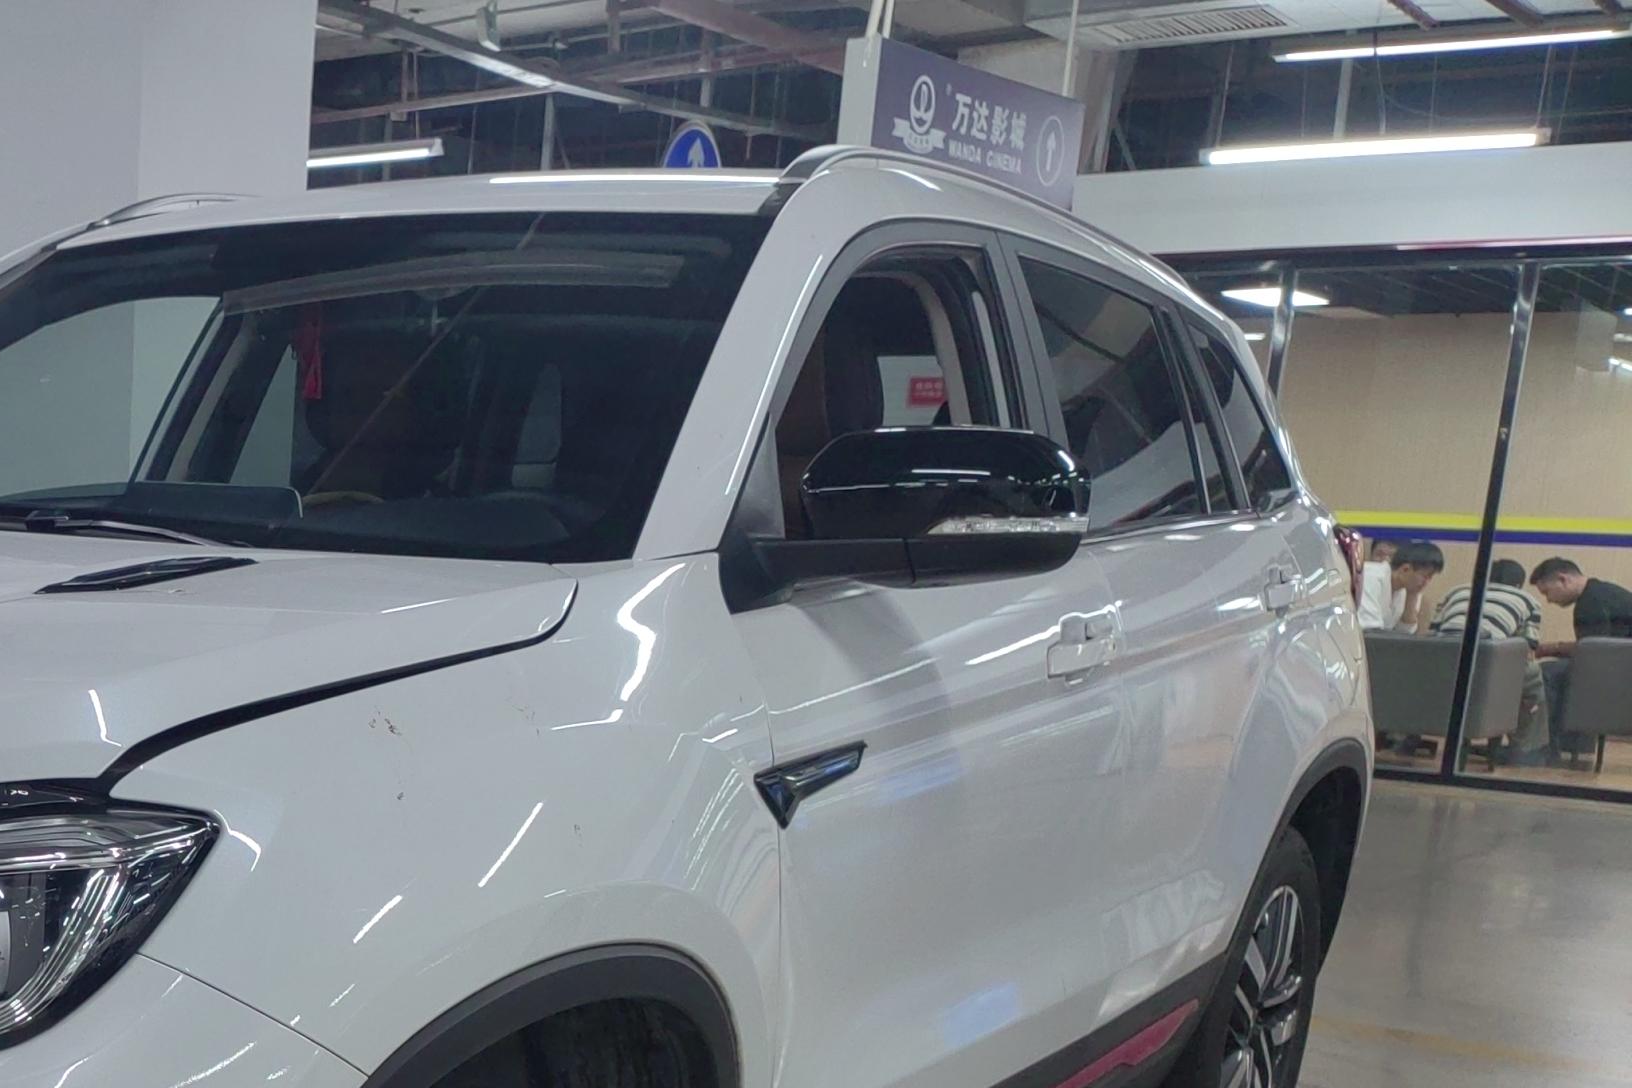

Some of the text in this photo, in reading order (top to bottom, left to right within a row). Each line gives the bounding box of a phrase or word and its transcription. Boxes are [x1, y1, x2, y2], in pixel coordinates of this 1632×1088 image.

[951, 92, 1028, 152] 万达影城
[948, 138, 981, 166] WANDA
[986, 149, 1022, 175] CINEMA
